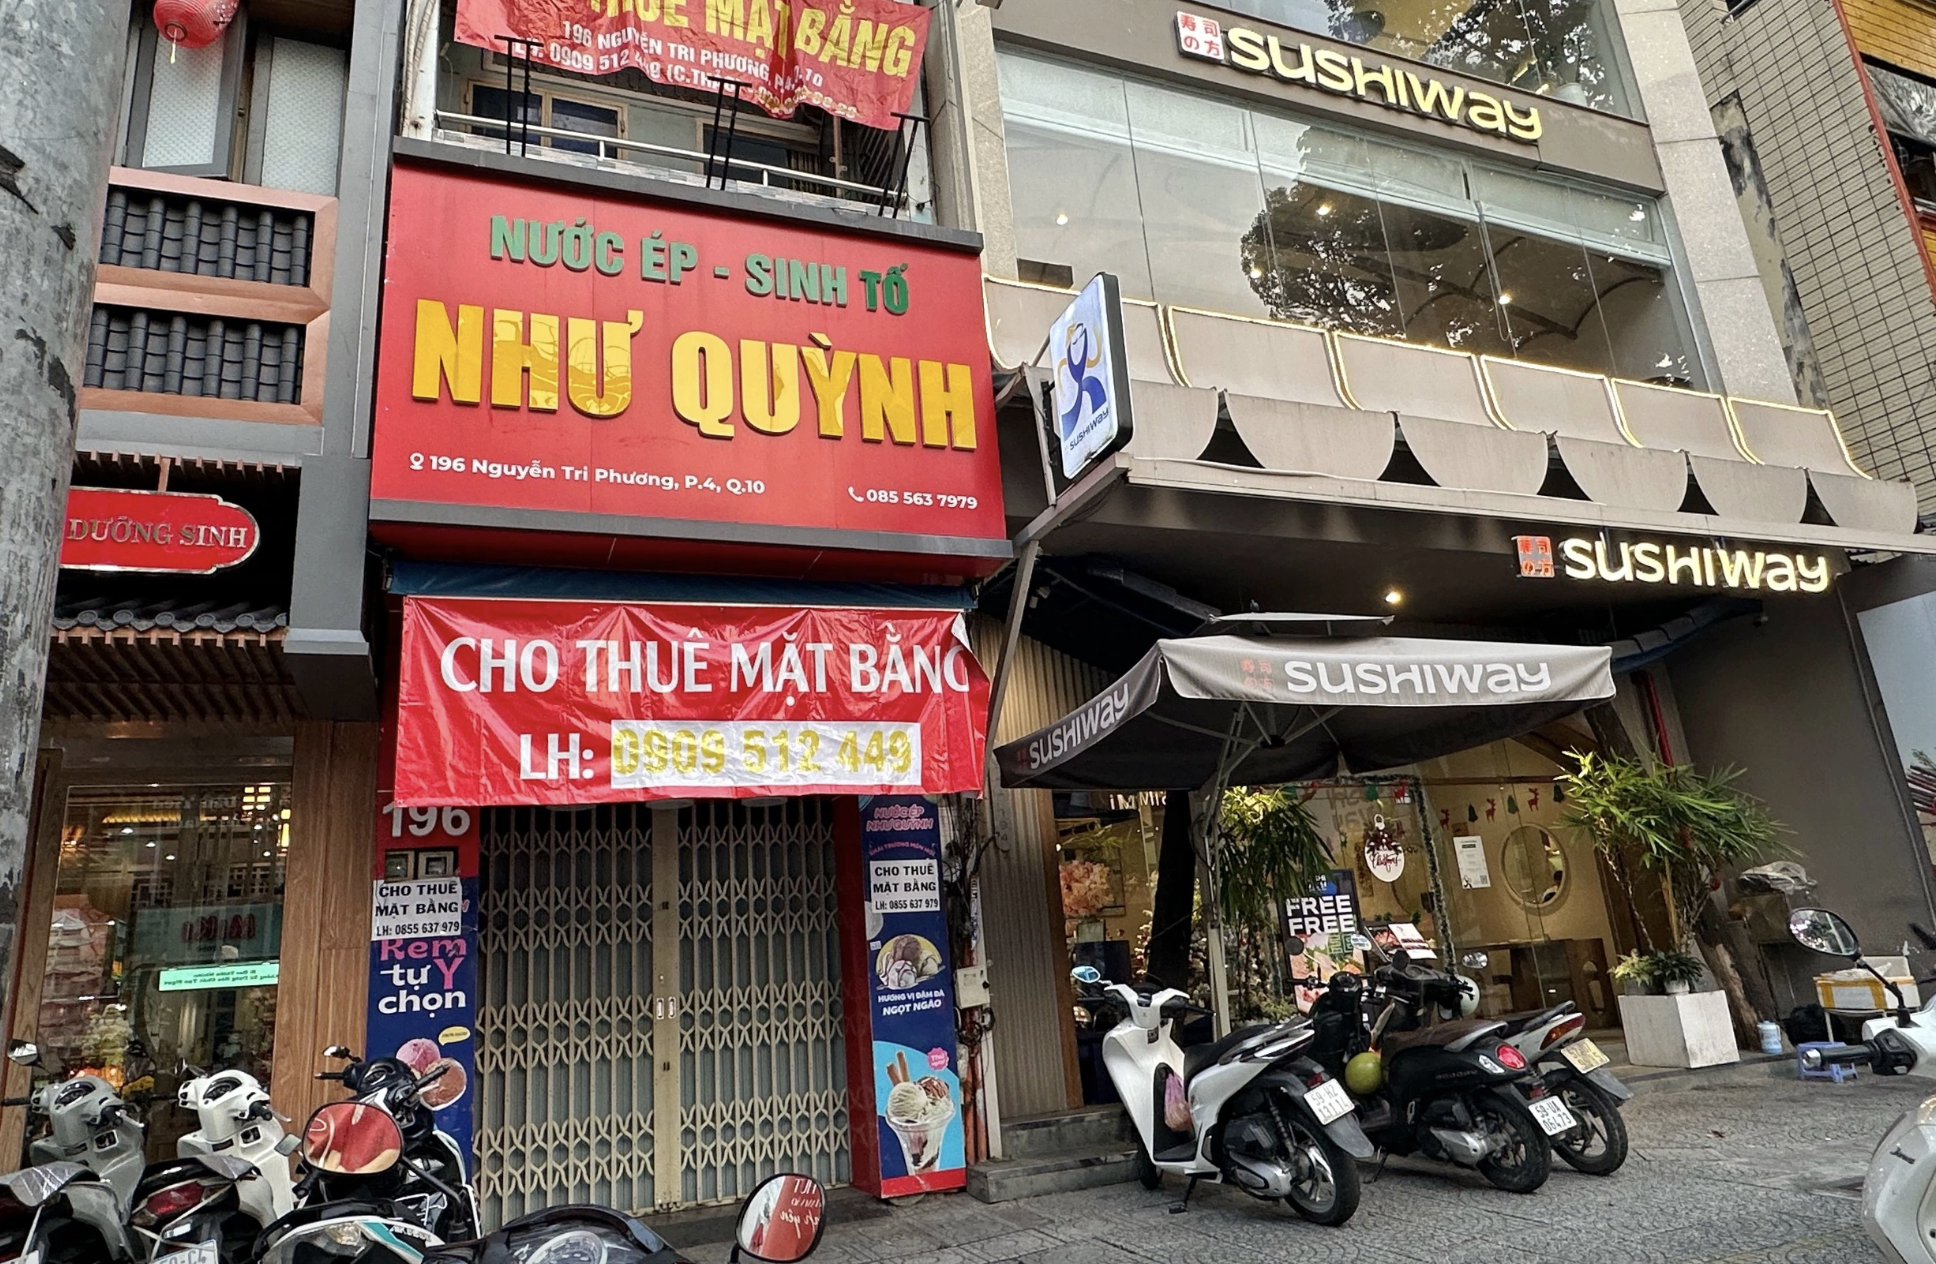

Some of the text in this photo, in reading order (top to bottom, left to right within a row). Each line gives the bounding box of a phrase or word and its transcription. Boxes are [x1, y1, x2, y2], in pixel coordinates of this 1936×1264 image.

[562, 21, 592, 47] 196
[597, 27, 662, 55] NGUYỄN
[667, 43, 695, 62] TRI
[550, 42, 594, 71] 0909
[600, 49, 629, 71] 512
[490, 214, 624, 277] NƯỚC
[641, 229, 698, 285] ÉP
[744, 253, 847, 307] SINH
[859, 262, 909, 316] TỐ
[412, 299, 979, 452] NHƯ QUỲNH
[429, 454, 765, 496] 196 Nguyễn Tri Phương, P.4, Q.10
[866, 488, 978, 510] 085 563 7979
[67, 515, 248, 548] DƯỠNG SINH
[439, 635, 559, 696] CHO
[576, 626, 714, 694] THUÊ
[729, 632, 834, 707] MẶT
[518, 726, 913, 780] LH: 0909 512 449
[382, 801, 470, 837] 196
[875, 863, 934, 876] CHO THUÊ
[379, 881, 458, 898] CHO THUÊ
[873, 878, 936, 895] MẶT BẰNG
[375, 902, 409, 919] MẶT
[416, 898, 459, 914] BẰNG
[875, 898, 938, 910] LH: 0855 637 979
[1285, 894, 1353, 916] FREE
[376, 921, 460, 936] LH: 0855 637 979
[1288, 914, 1356, 936] FREE
[380, 938, 467, 961] Kem
[380, 963, 432, 991] tự
[378, 989, 466, 1018] chọn
[882, 999, 942, 1016] NGỌT NGÀO
